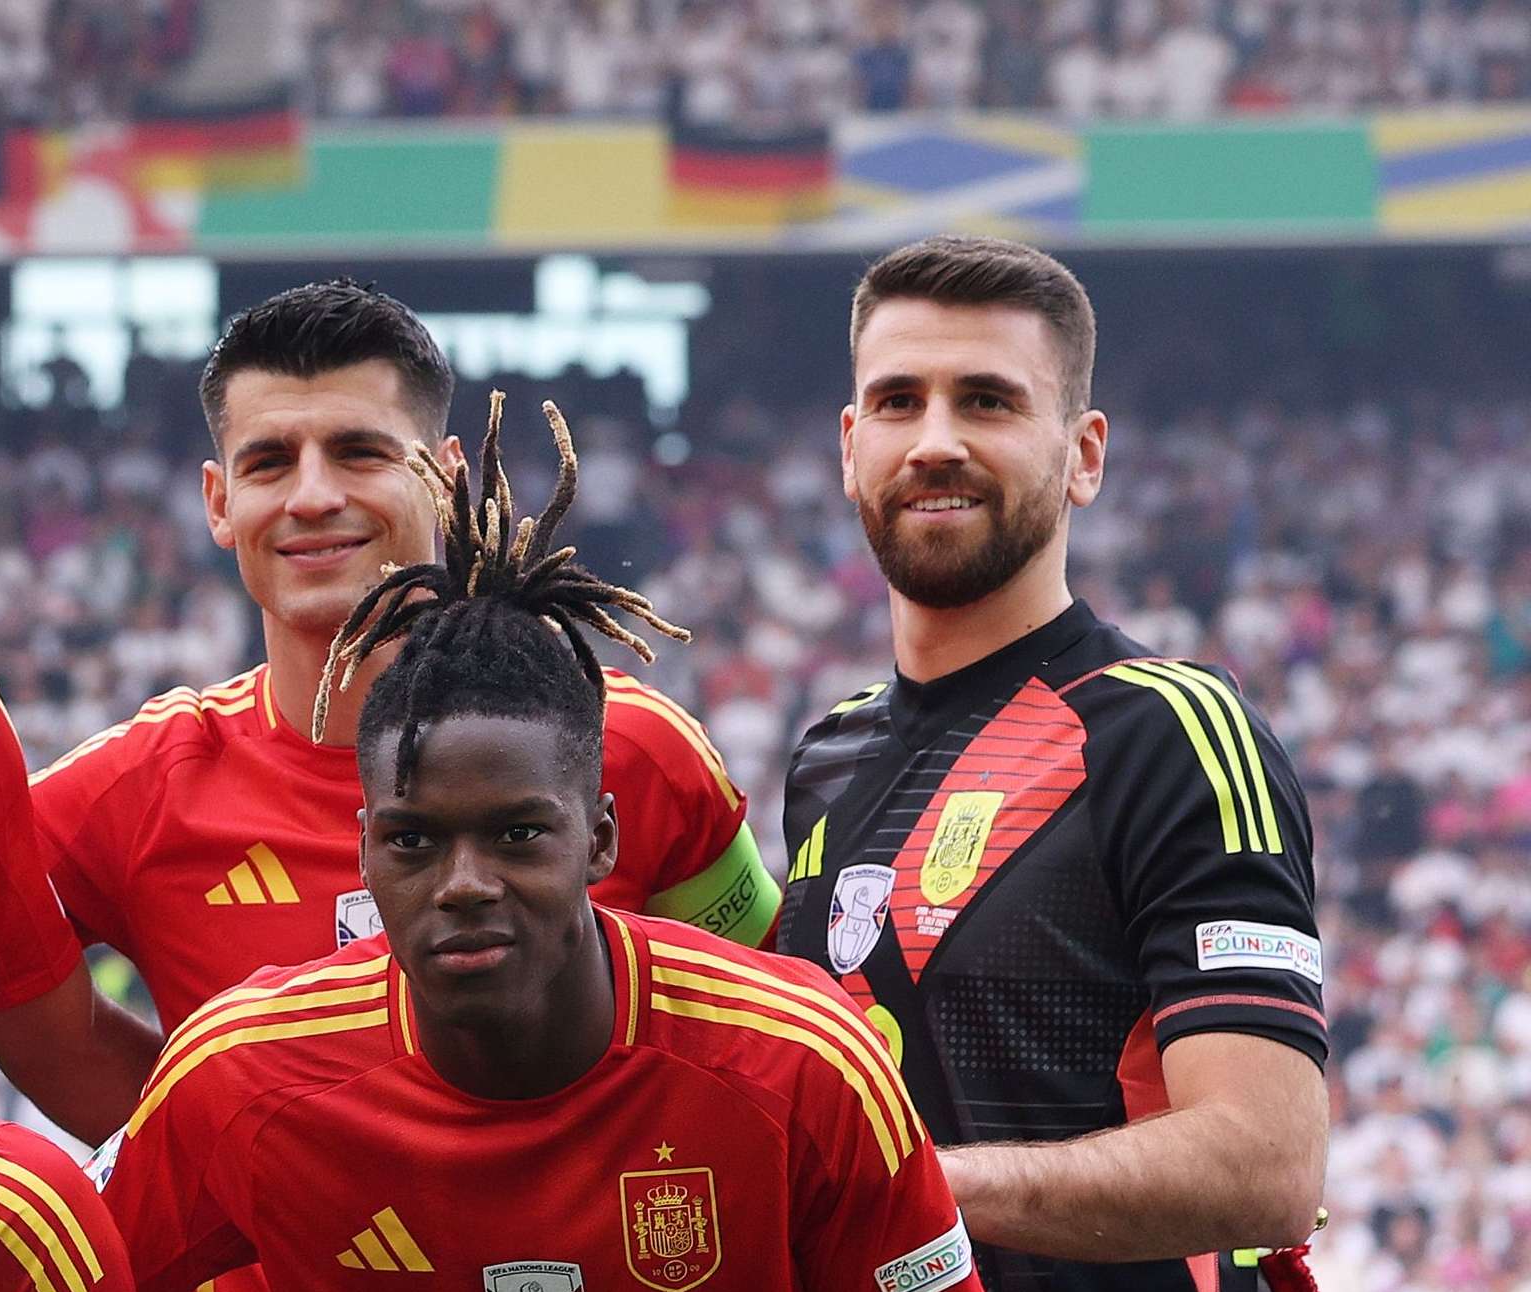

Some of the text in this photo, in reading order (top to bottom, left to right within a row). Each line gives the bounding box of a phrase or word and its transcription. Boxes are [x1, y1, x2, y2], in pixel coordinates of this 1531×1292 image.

[1201, 925, 1232, 936] UEFA
[1201, 936, 1319, 966] FOUNDATION
[487, 1264, 575, 1276] UEFA NATIONS LEAGUE
[880, 1260, 909, 1280] UEFA
